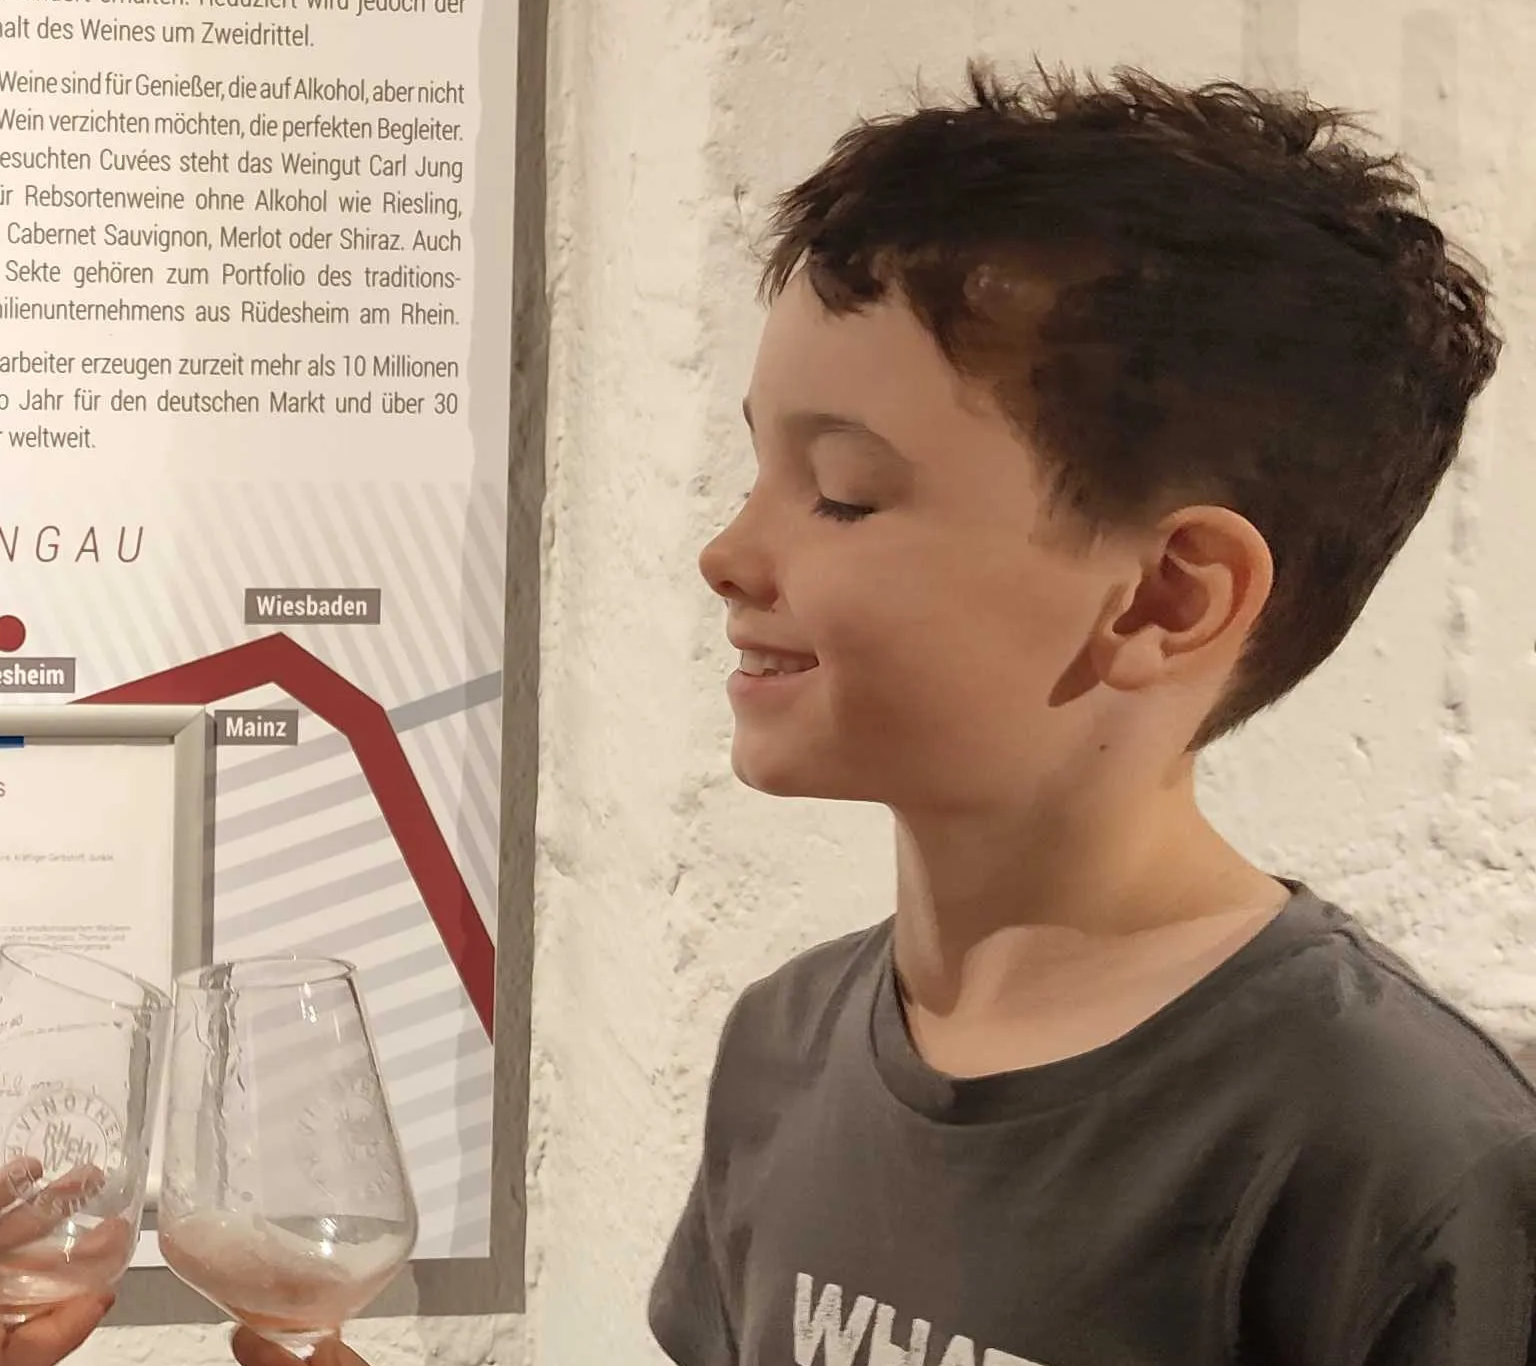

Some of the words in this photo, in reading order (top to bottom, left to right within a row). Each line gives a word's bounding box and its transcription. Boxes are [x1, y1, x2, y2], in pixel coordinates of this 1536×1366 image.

[36, 15, 75, 40] des
[79, 17, 156, 43] Weines
[161, 25, 195, 44] um
[200, 20, 315, 47] Zweidrittel.
[99, 147, 172, 172] Cuvées
[179, 148, 230, 174] steht
[237, 149, 273, 175] das
[280, 151, 362, 182] Weingut
[369, 153, 407, 178] Carl
[414, 154, 464, 184] Jung
[7, 220, 97, 246] Cabernet
[103, 222, 213, 253] Sauvignon,
[219, 224, 283, 250] Merlot
[288, 225, 334, 250] oder
[339, 226, 405, 252] Shiraz.
[411, 228, 462, 252] Auch
[4, 258, 62, 283] Sekte
[73, 259, 154, 289] gehören
[165, 267, 210, 286] zum
[222, 261, 306, 287] Portfolio
[317, 263, 353, 288] des
[363, 264, 462, 289] traditions-
[195, 304, 231, 323] aus
[241, 299, 350, 324] Rüdesheim
[359, 307, 391, 325] am
[401, 301, 460, 326] Rhein.
[80, 356, 172, 381] erzeugen
[177, 352, 245, 377] zurzeit
[250, 352, 304, 377] mehr
[307, 352, 336, 378] als
[342, 354, 367, 378] 10
[372, 353, 459, 379] Millionen
[7, 424, 96, 449] weltweit.
[256, 594, 368, 617] Wiesbaden
[225, 715, 288, 739] Mainz
